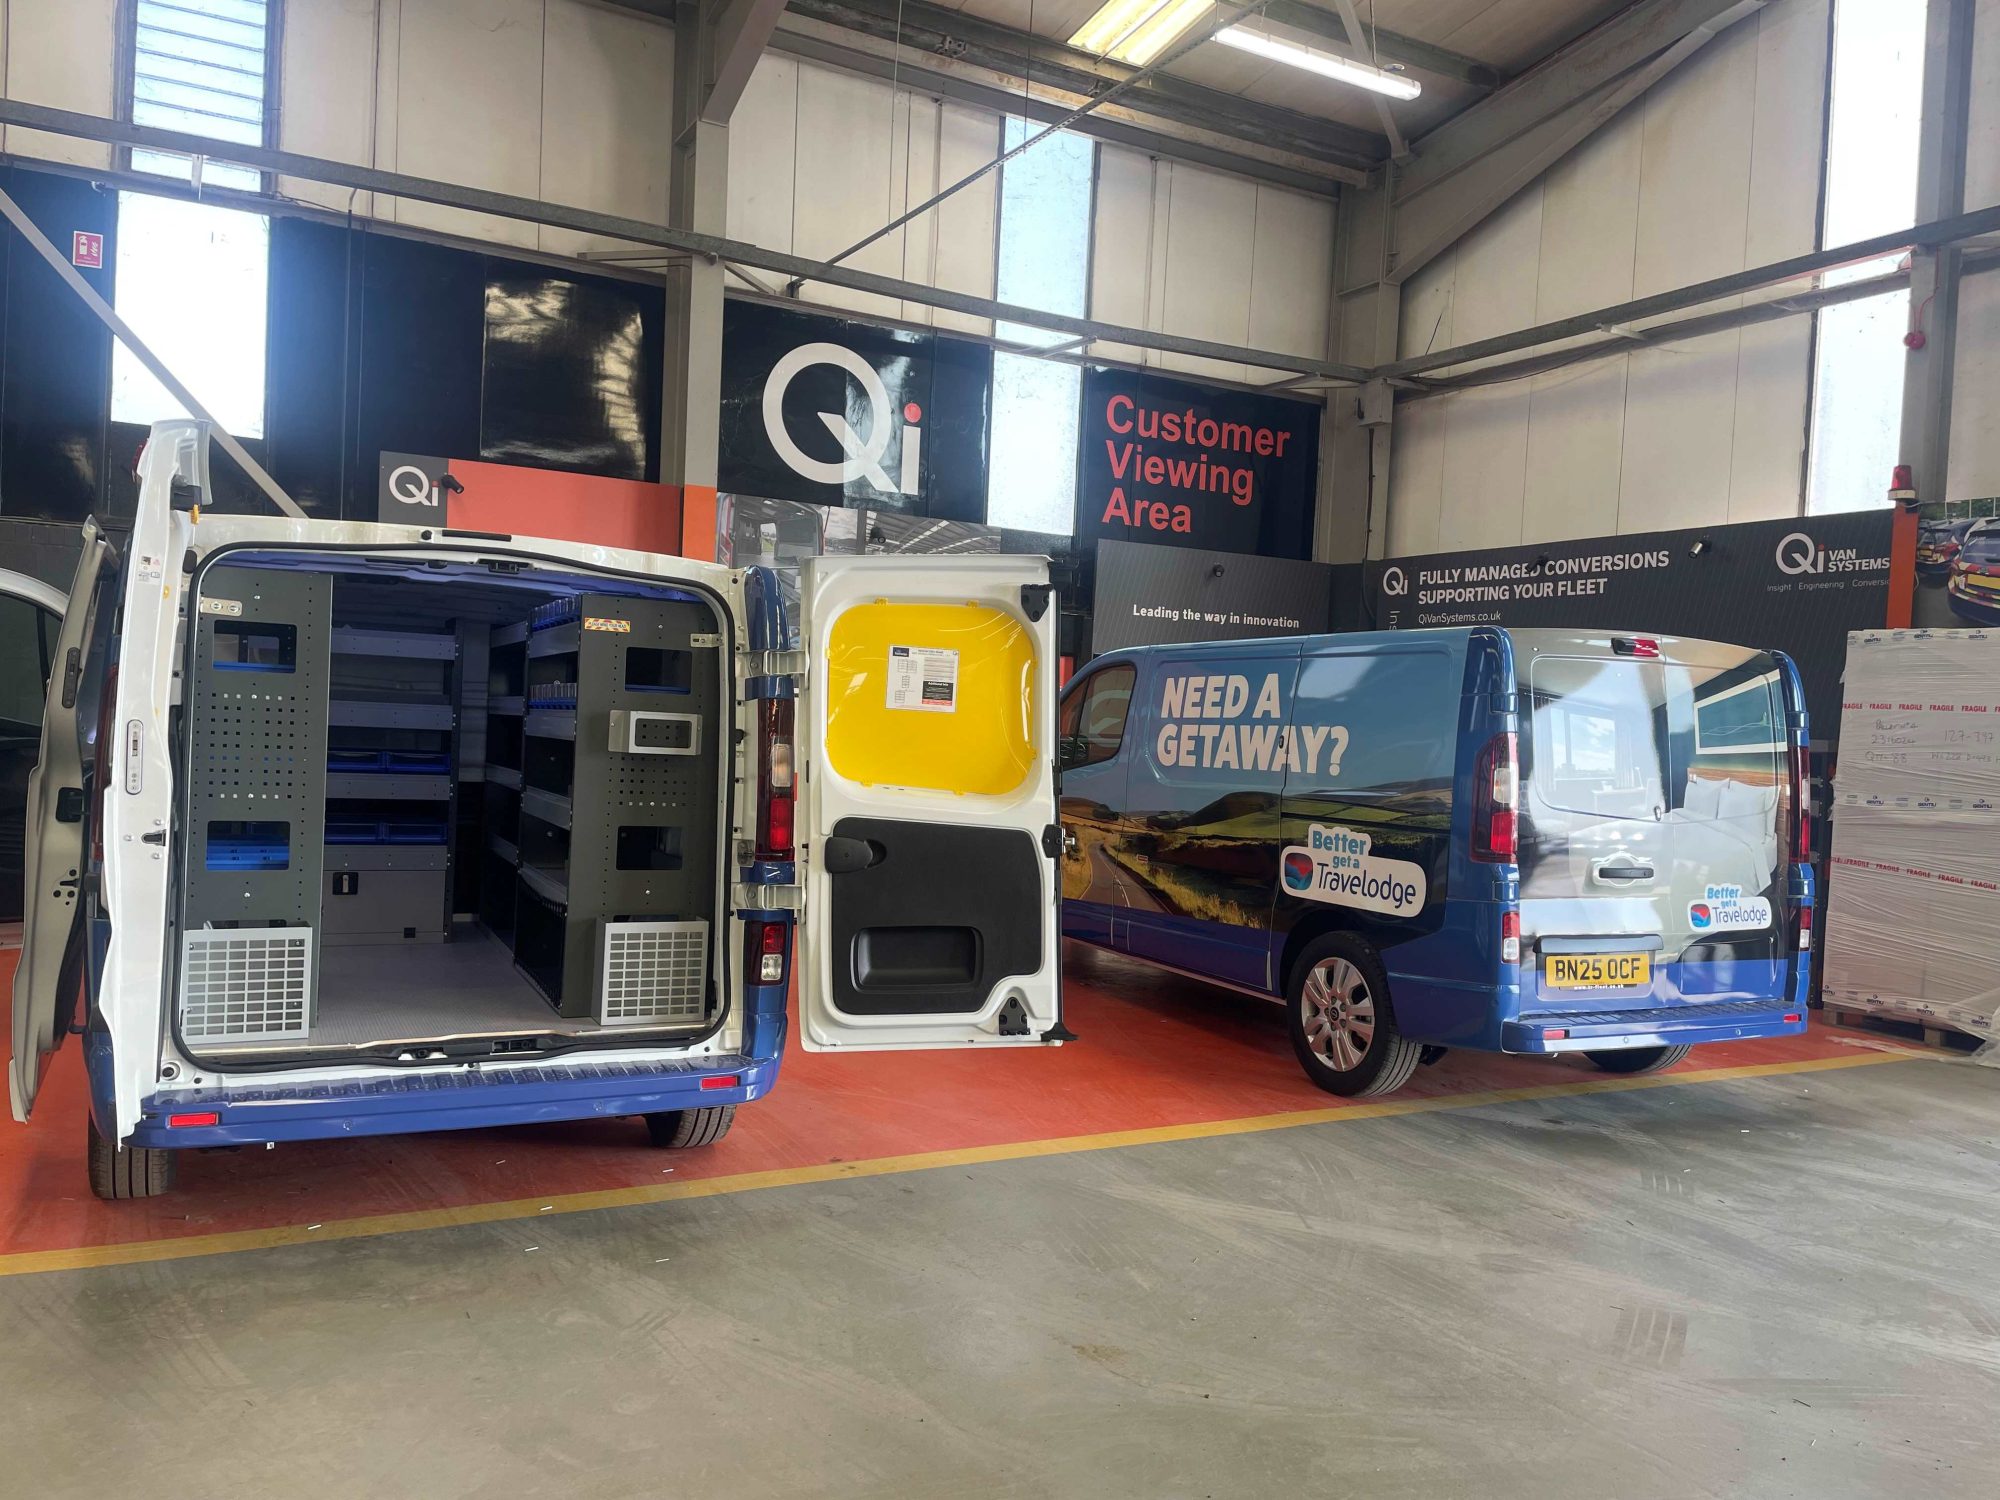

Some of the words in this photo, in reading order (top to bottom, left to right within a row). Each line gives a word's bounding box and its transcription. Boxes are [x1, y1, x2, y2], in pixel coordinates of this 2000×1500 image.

[763, 342, 922, 496] Qi
[1106, 395, 1291, 457] Customer
[389, 465, 439, 507] Qi
[1105, 440, 1254, 506] Viewing
[1102, 487, 1192, 533] Area
[1776, 532, 1825, 575] Qi
[1828, 548, 1857, 561] VAN
[1828, 557, 1891, 573] SYSTEMS
[1419, 568, 1462, 586] FULLY
[1544, 550, 1670, 576] CONVERSIONS
[1382, 566, 1409, 597] Qi
[1418, 584, 1510, 605] SUPPORTING
[1513, 580, 1554, 598] YOUR
[1557, 577, 1608, 597] FLEET
[1767, 582, 1792, 592] Insight
[1798, 580, 1845, 591] Engineering
[1133, 604, 1179, 621] Leading
[1182, 608, 1201, 621] the
[1204, 612, 1227, 625] way
[1229, 612, 1240, 625] in
[1243, 613, 1300, 629] innovation
[1418, 610, 1501, 625] QiVanSystems.co.uk
[1160, 674, 1250, 719] NEED
[1252, 673, 1281, 719] A
[1898, 703, 1923, 711] FRAGILE
[1929, 704, 1954, 712] FRAGILE
[1961, 705, 1987, 713] FRAGILE
[1157, 723, 1350, 776] GETAWAY?
[1312, 830, 1367, 855] Better
[1333, 854, 1352, 869] get
[1353, 858, 1360, 868] a
[1316, 862, 1417, 909] Travelodge
[1876, 863, 1900, 873] FRAGILE
[1906, 868, 1931, 879] FRAGILE
[1938, 874, 1964, 885] FRAGILE
[1970, 880, 1997, 891] FRAGILE
[1707, 887, 1740, 899] Better
[1720, 900, 1732, 909] get
[1712, 905, 1767, 925] Travelodge
[1555, 958, 1603, 981] BN25
[1607, 958, 1641, 979] OCF
